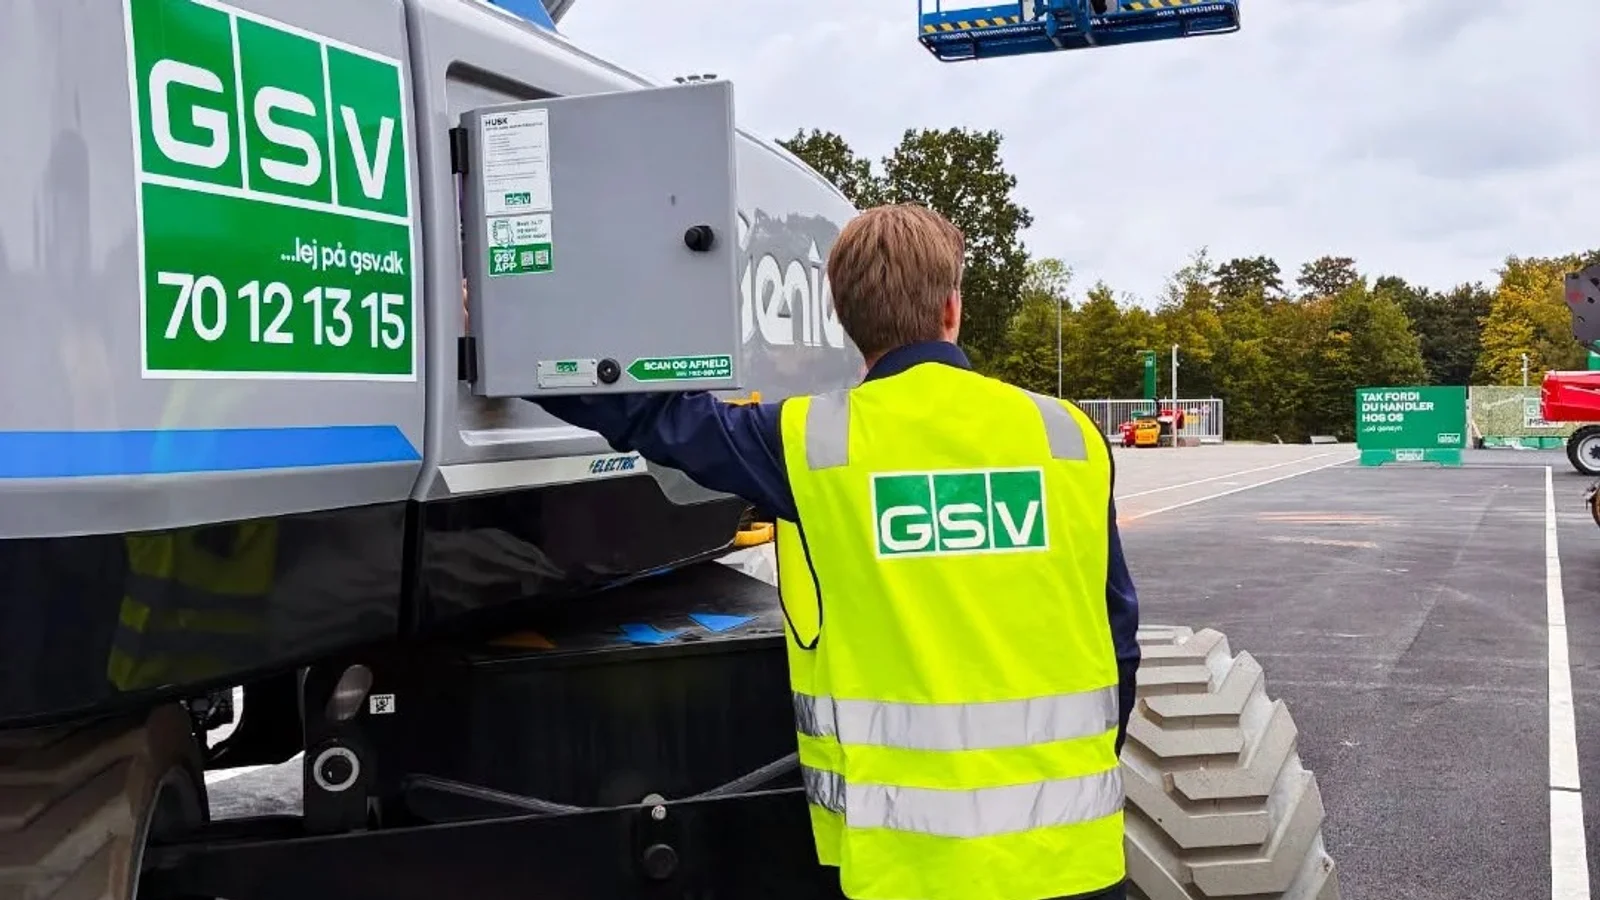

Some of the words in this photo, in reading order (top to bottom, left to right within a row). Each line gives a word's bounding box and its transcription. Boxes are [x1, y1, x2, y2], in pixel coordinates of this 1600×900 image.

[148, 58, 395, 201] GSV
[280, 237, 318, 269] ...lej
[321, 241, 347, 269] på
[350, 247, 404, 275] gsv.dk
[494, 262, 517, 273] APP
[157, 271, 228, 342] 70
[237, 280, 294, 345] 12
[303, 286, 353, 347] 13
[360, 292, 405, 350] 15
[643, 361, 671, 371] SCAN
[672, 360, 688, 369] OG
[688, 358, 728, 369] AFMELD
[1361, 393, 1384, 402] TAK
[1385, 391, 1420, 401] FORDI
[1362, 403, 1379, 412] DU
[1380, 402, 1434, 411] HANDLER
[1362, 413, 1386, 422] HOS
[1387, 413, 1404, 422] OS
[880, 500, 1039, 551] GSV
